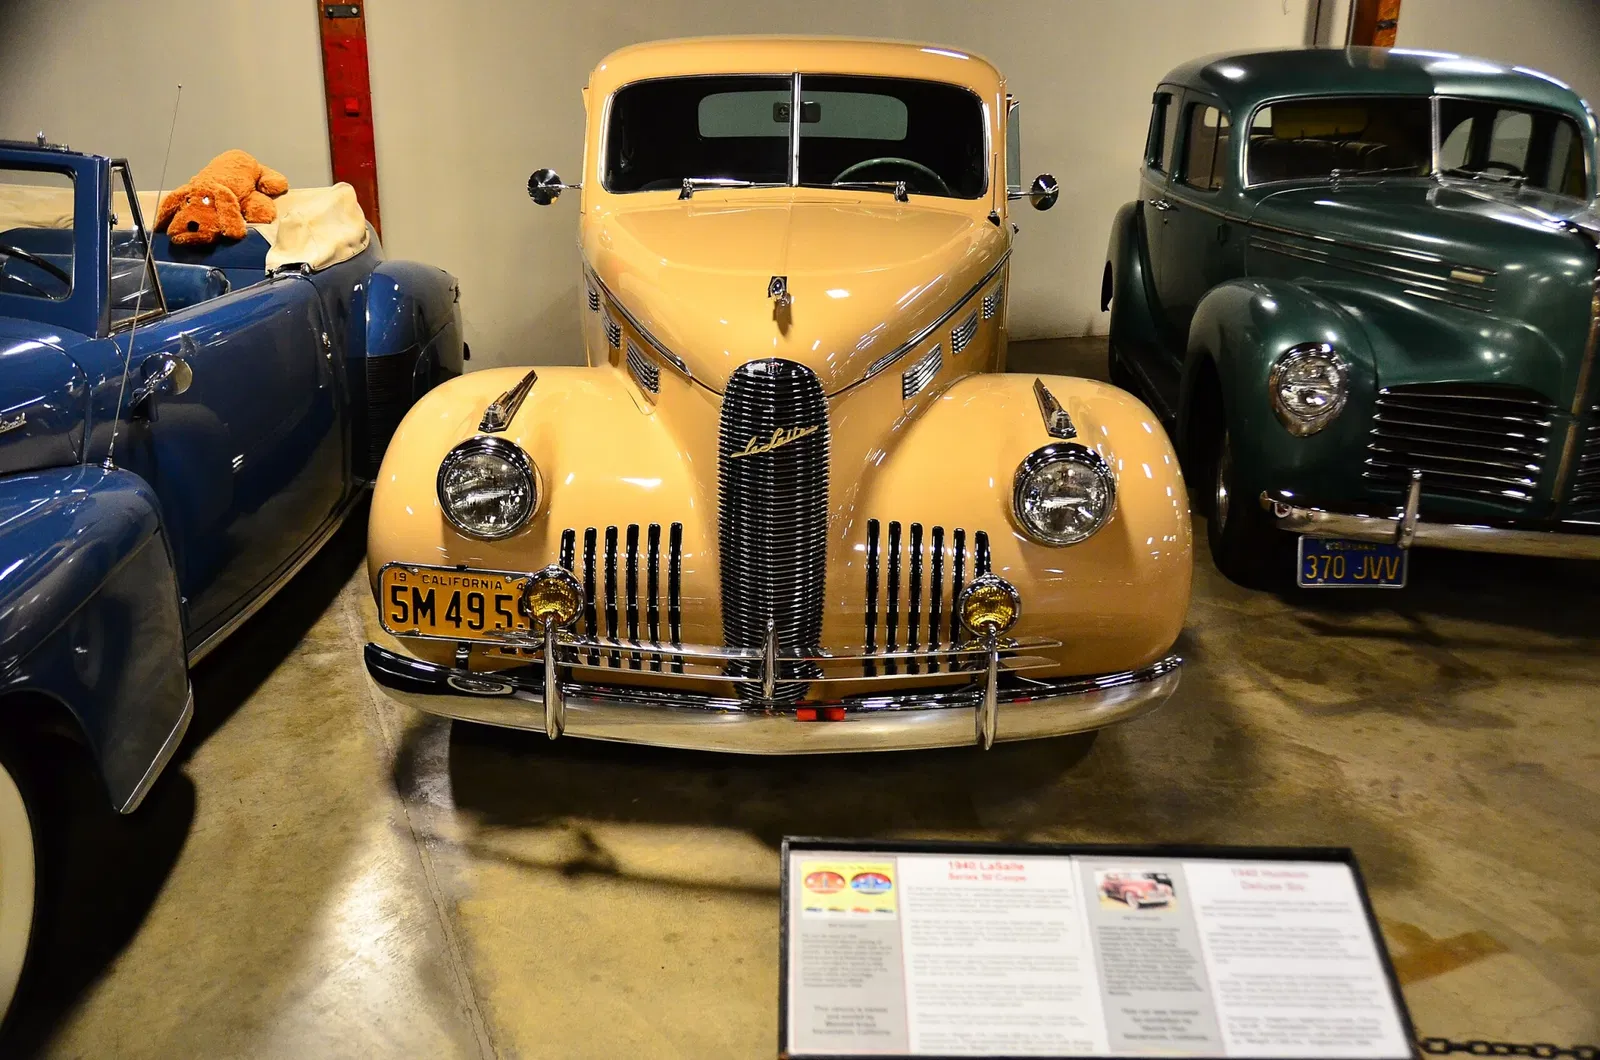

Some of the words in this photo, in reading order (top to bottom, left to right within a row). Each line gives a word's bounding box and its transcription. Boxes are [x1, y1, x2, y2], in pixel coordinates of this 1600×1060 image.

[730, 425, 819, 458] LaSalle
[1305, 555, 1345, 579] 370
[1353, 556, 1400, 580] JVV
[393, 572, 407, 583] 19
[421, 573, 503, 591] CALIFORNIA
[947, 860, 977, 871] 1940
[979, 861, 1025, 872] LaSalle
